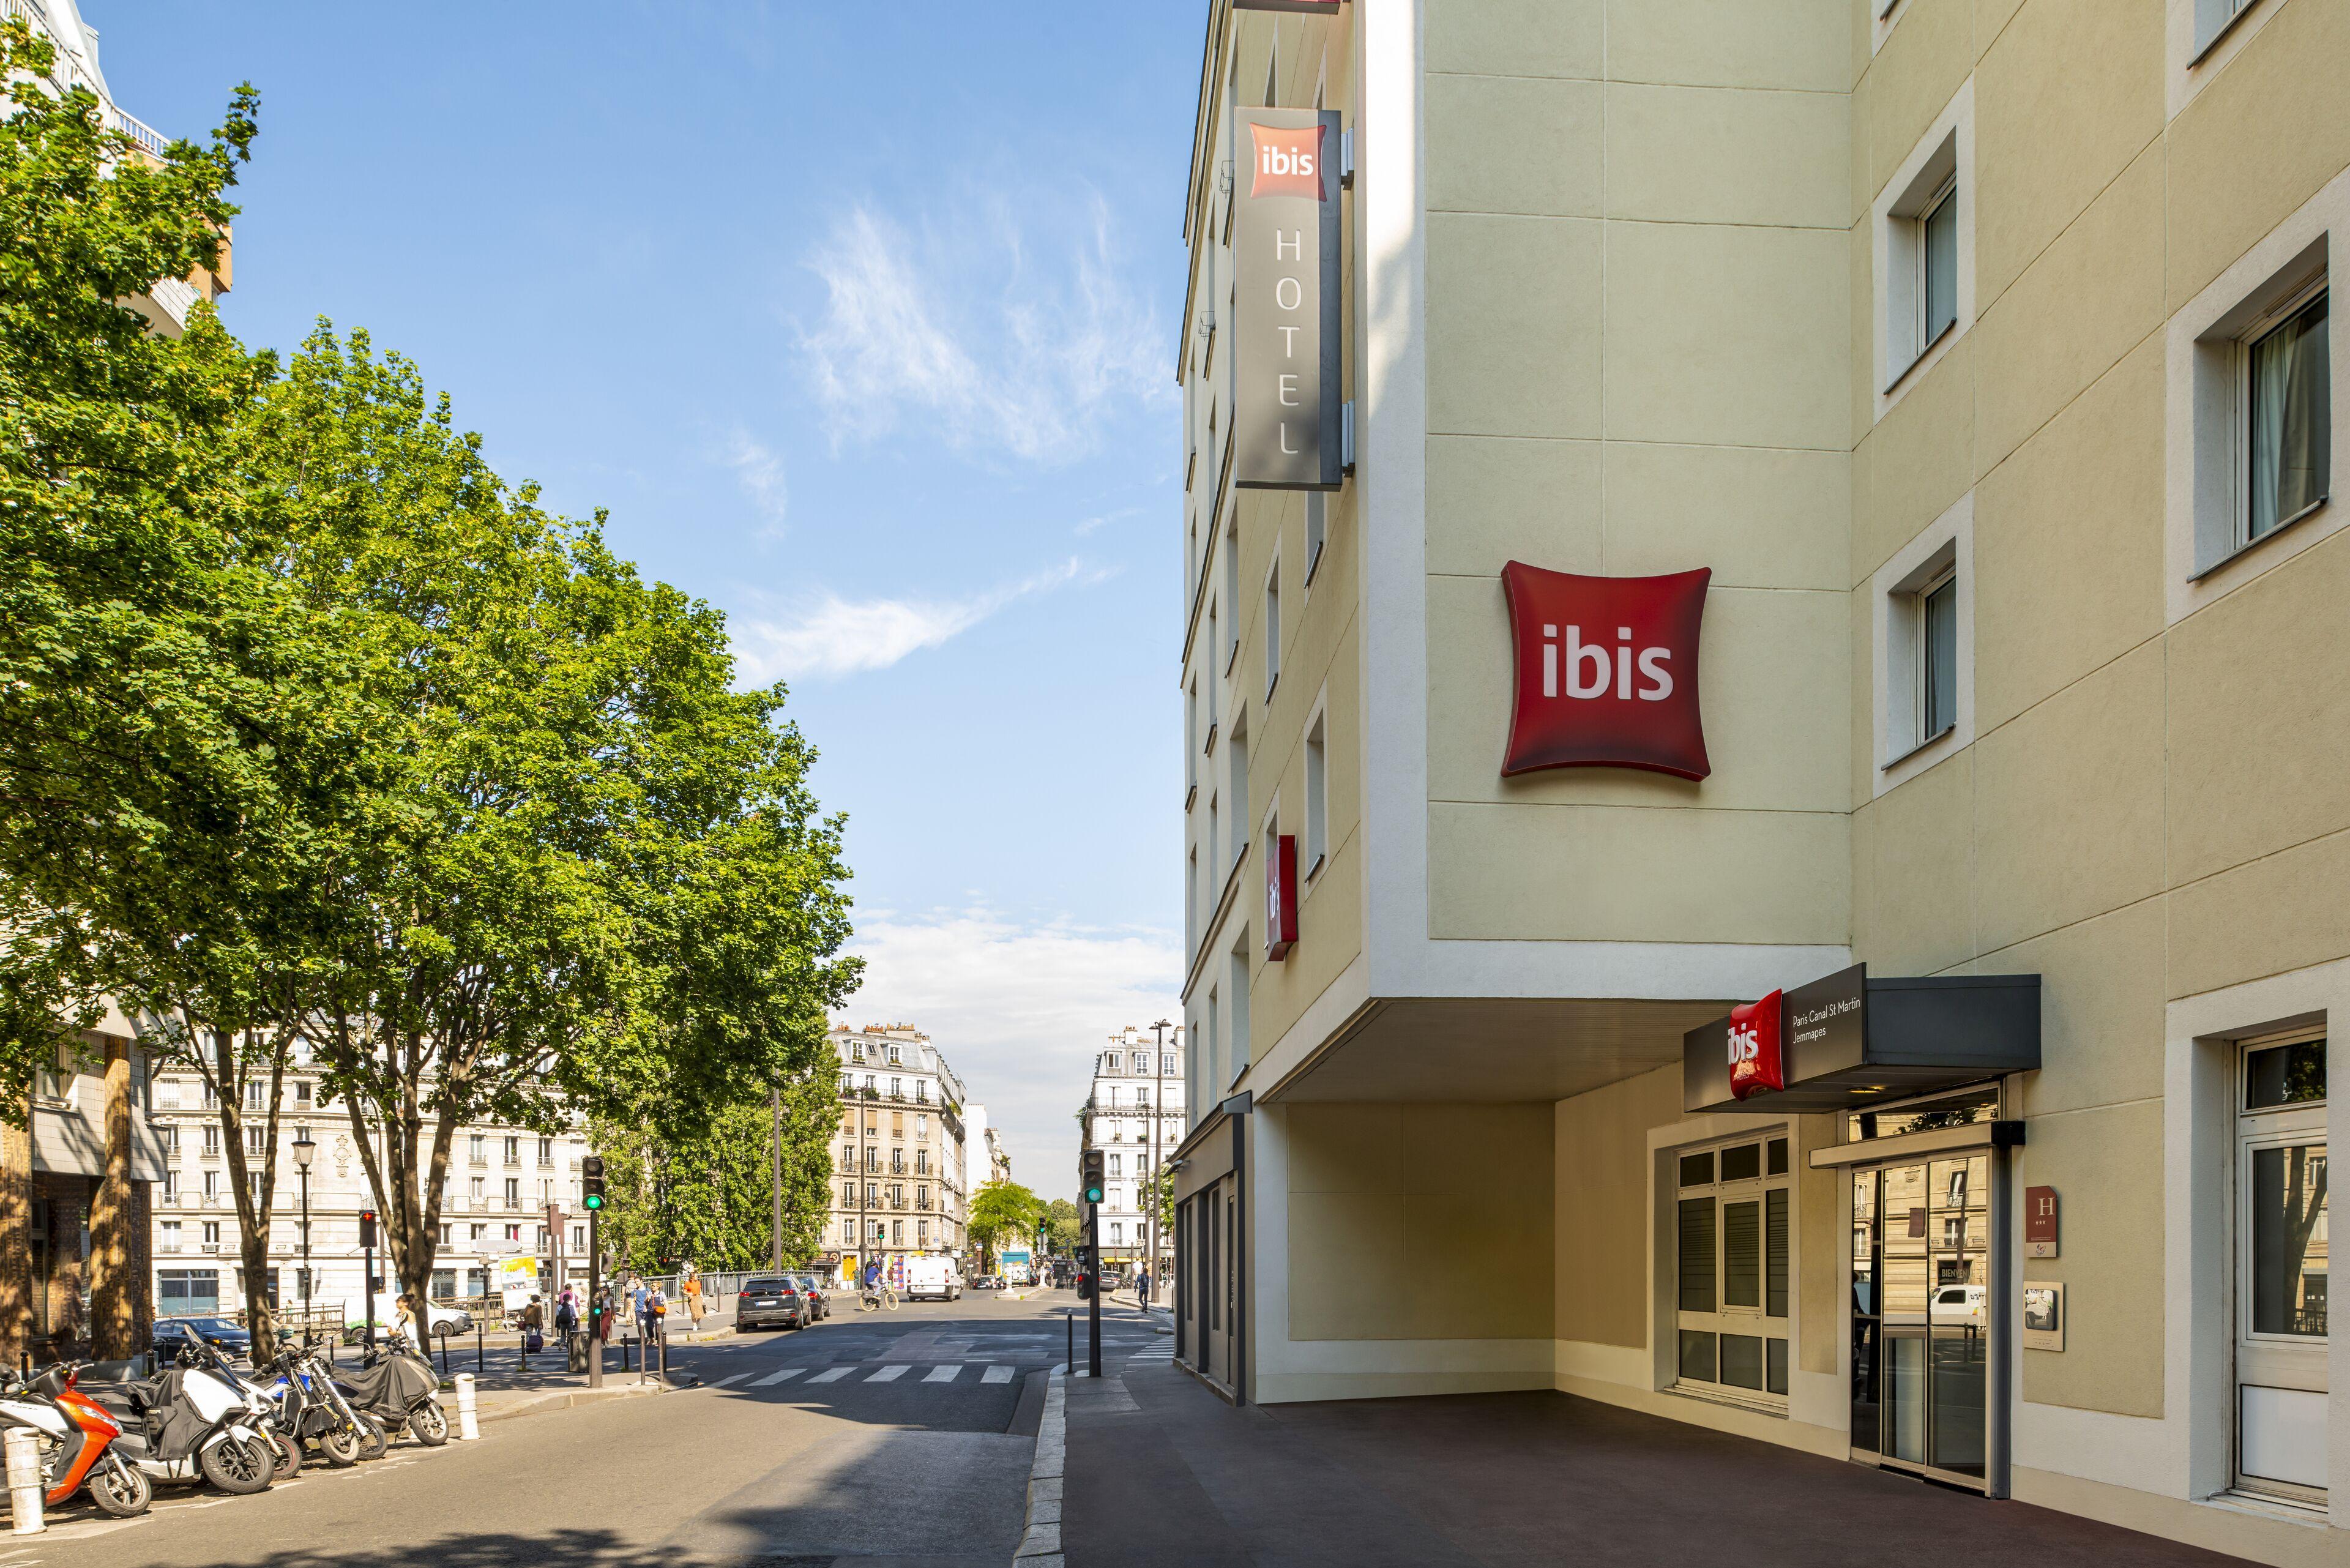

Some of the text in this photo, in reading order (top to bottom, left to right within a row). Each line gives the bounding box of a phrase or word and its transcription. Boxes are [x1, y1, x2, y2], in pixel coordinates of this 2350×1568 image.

[1263, 146, 1313, 176] ibis
[1275, 228, 1303, 455] HOTEL
[1543, 624, 1674, 701] ibis
[1793, 997, 1860, 1028] Paris Canal St Martin
[1728, 1023, 1759, 1066] ibis
[1793, 1028, 1826, 1043] Jemmapes
[2038, 1197, 2056, 1216] H
